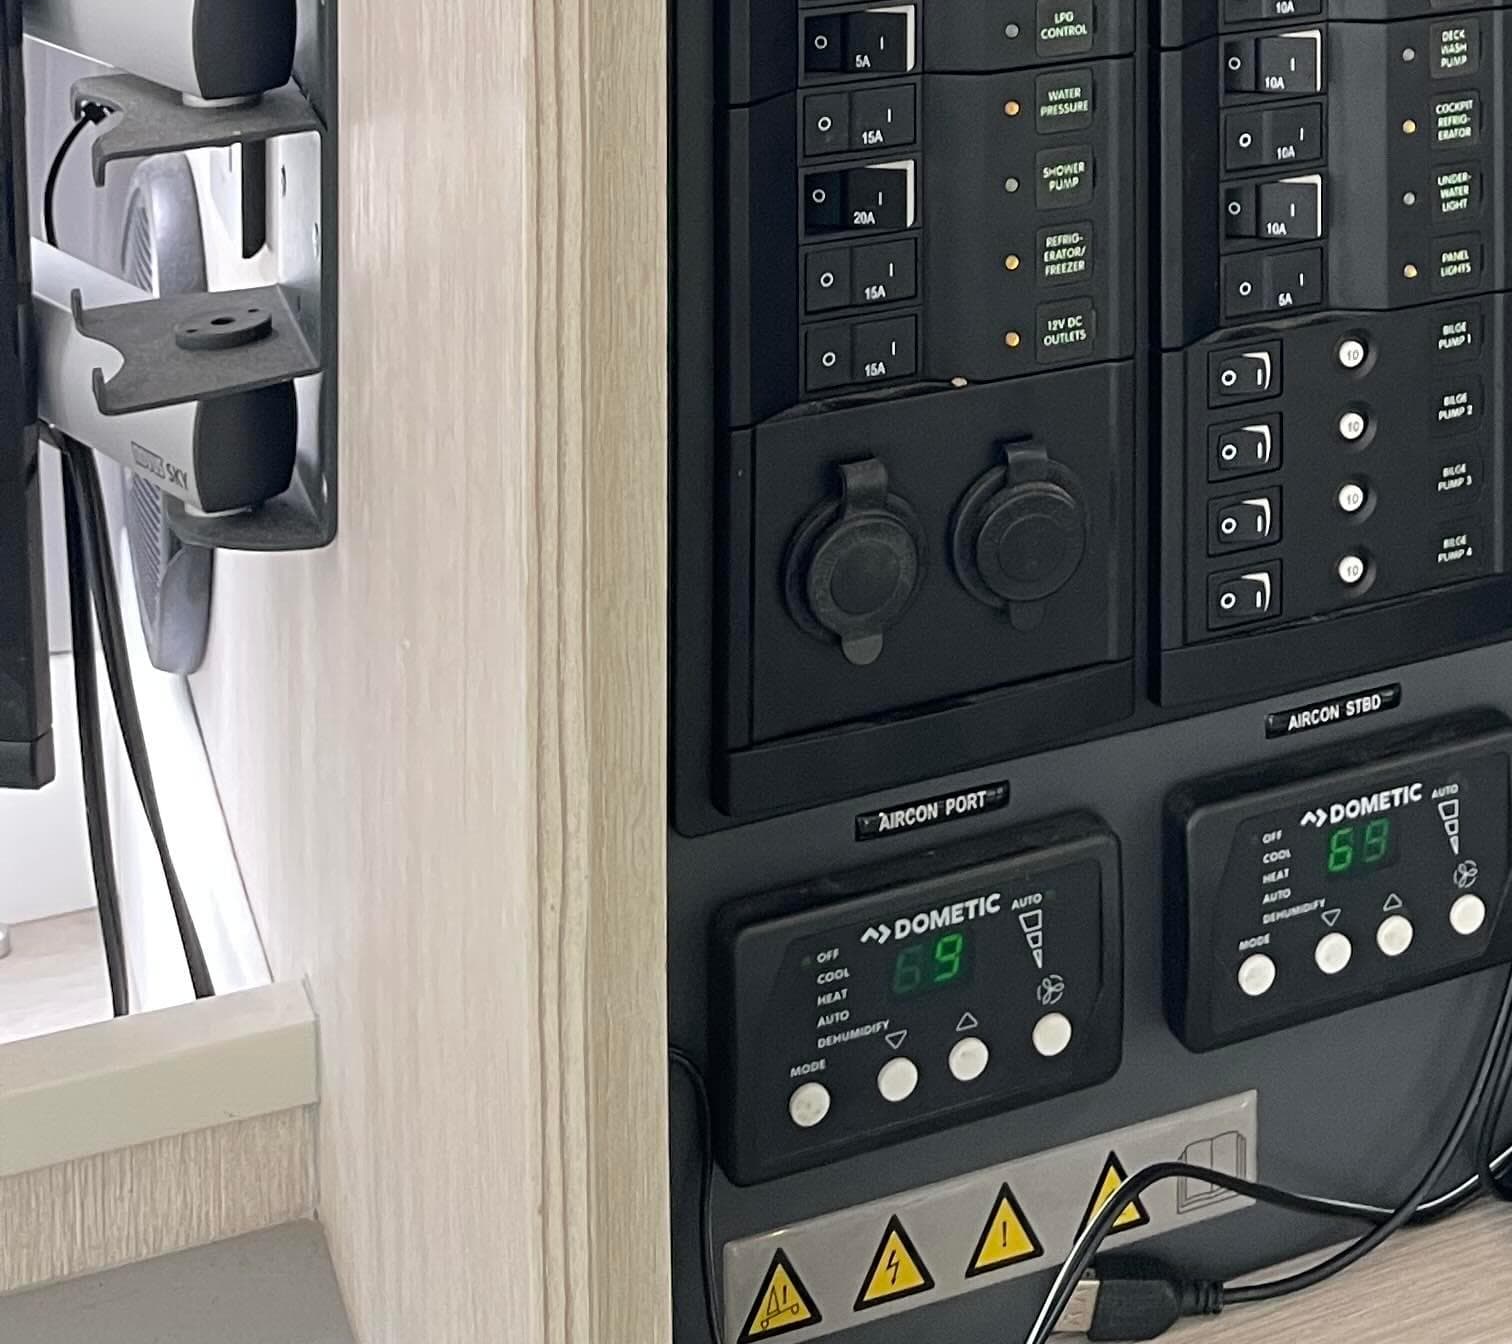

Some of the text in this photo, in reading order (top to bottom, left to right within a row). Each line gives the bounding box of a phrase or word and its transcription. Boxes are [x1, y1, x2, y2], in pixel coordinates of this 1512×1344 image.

[1041, 24, 1087, 39] CONTROL
[1288, 695, 1381, 731] AIRCON STBD
[878, 790, 986, 832] AIRCON PORT
[1330, 783, 1423, 824] DOMETIC
[895, 893, 1001, 939] DOMETIC
[817, 948, 839, 963] OFF
[817, 968, 850, 984] COOL
[817, 988, 847, 1006] HEAT
